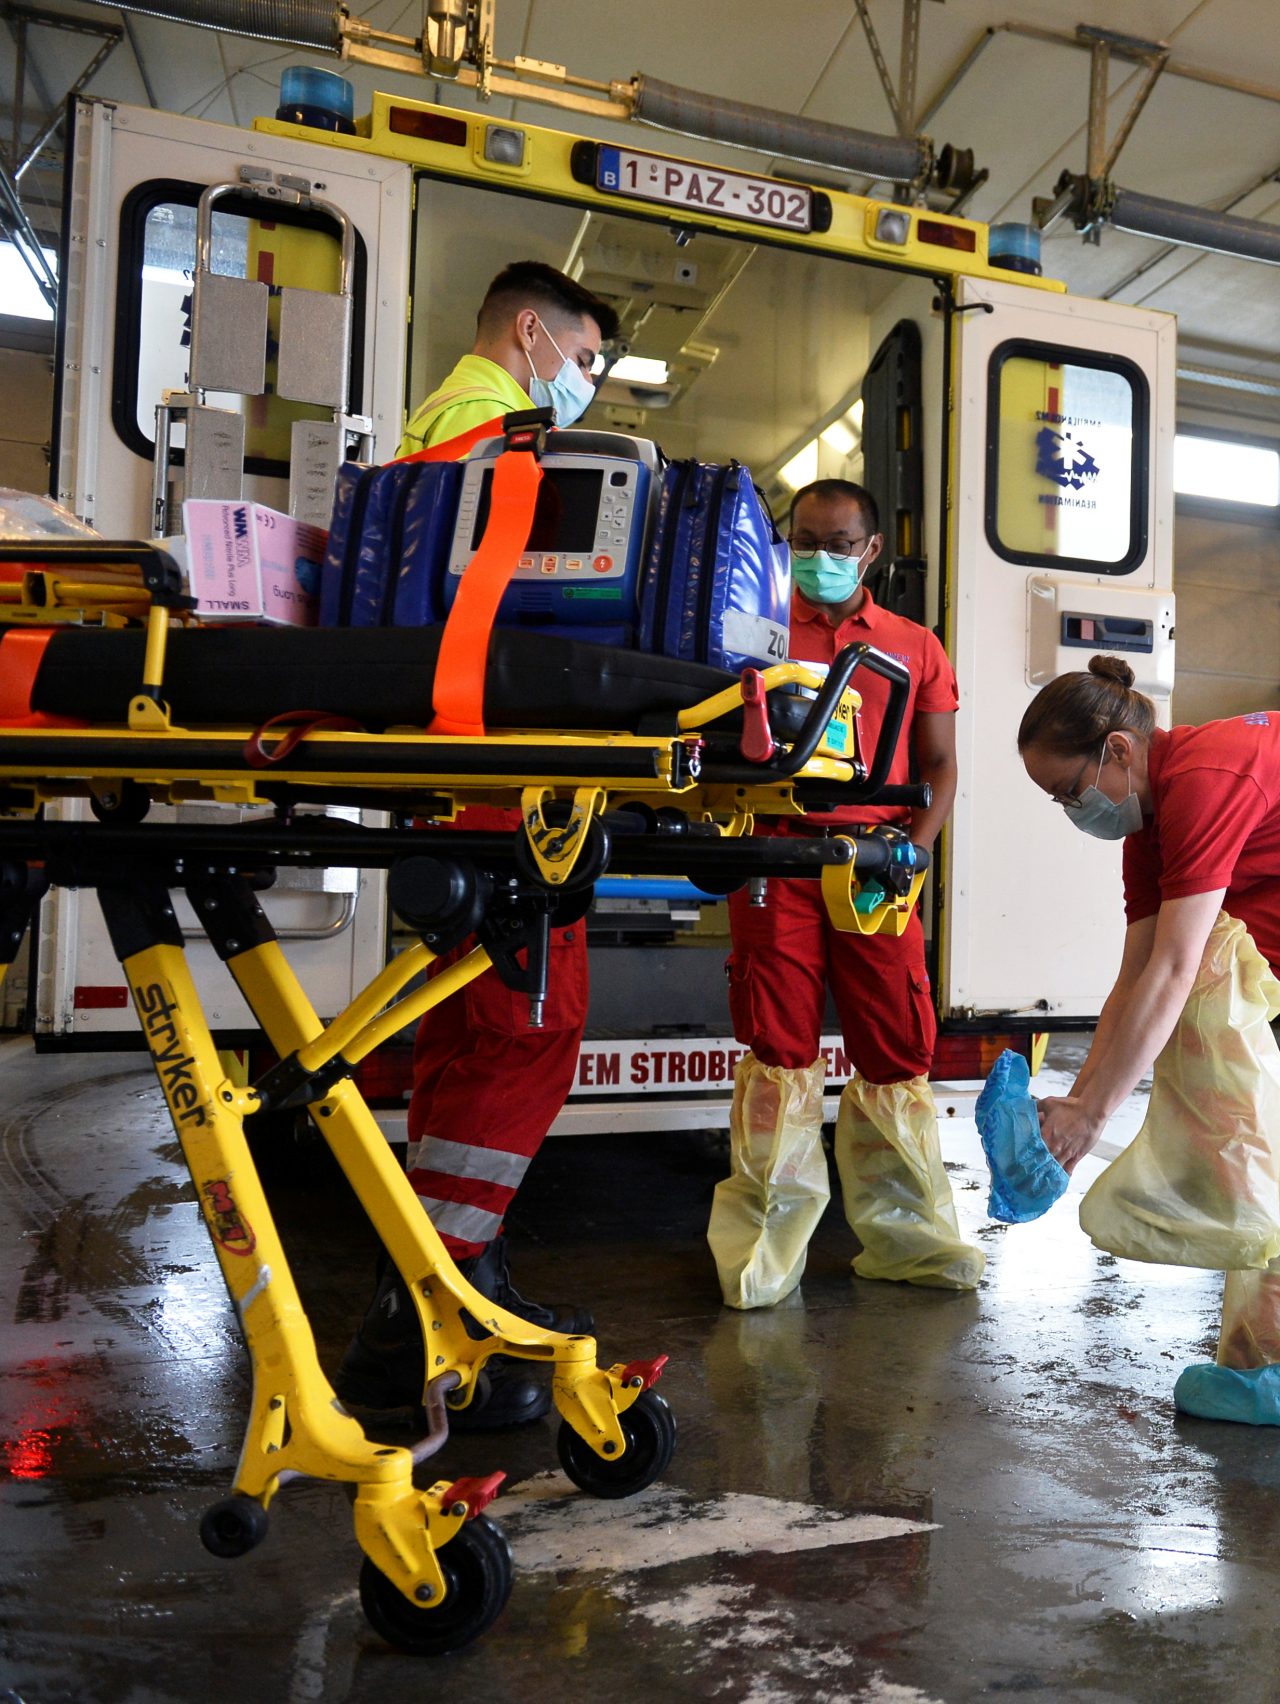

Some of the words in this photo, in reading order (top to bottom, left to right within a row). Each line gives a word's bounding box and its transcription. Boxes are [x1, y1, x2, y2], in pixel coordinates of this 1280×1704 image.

[604, 172, 616, 186] B
[228, 580, 236, 597] Long
[205, 600, 249, 610] SMALL
[135, 983, 205, 1128] stryker
[579, 1052, 620, 1086] EM
[630, 1050, 751, 1084] STROBE
[821, 1047, 851, 1077] EN
